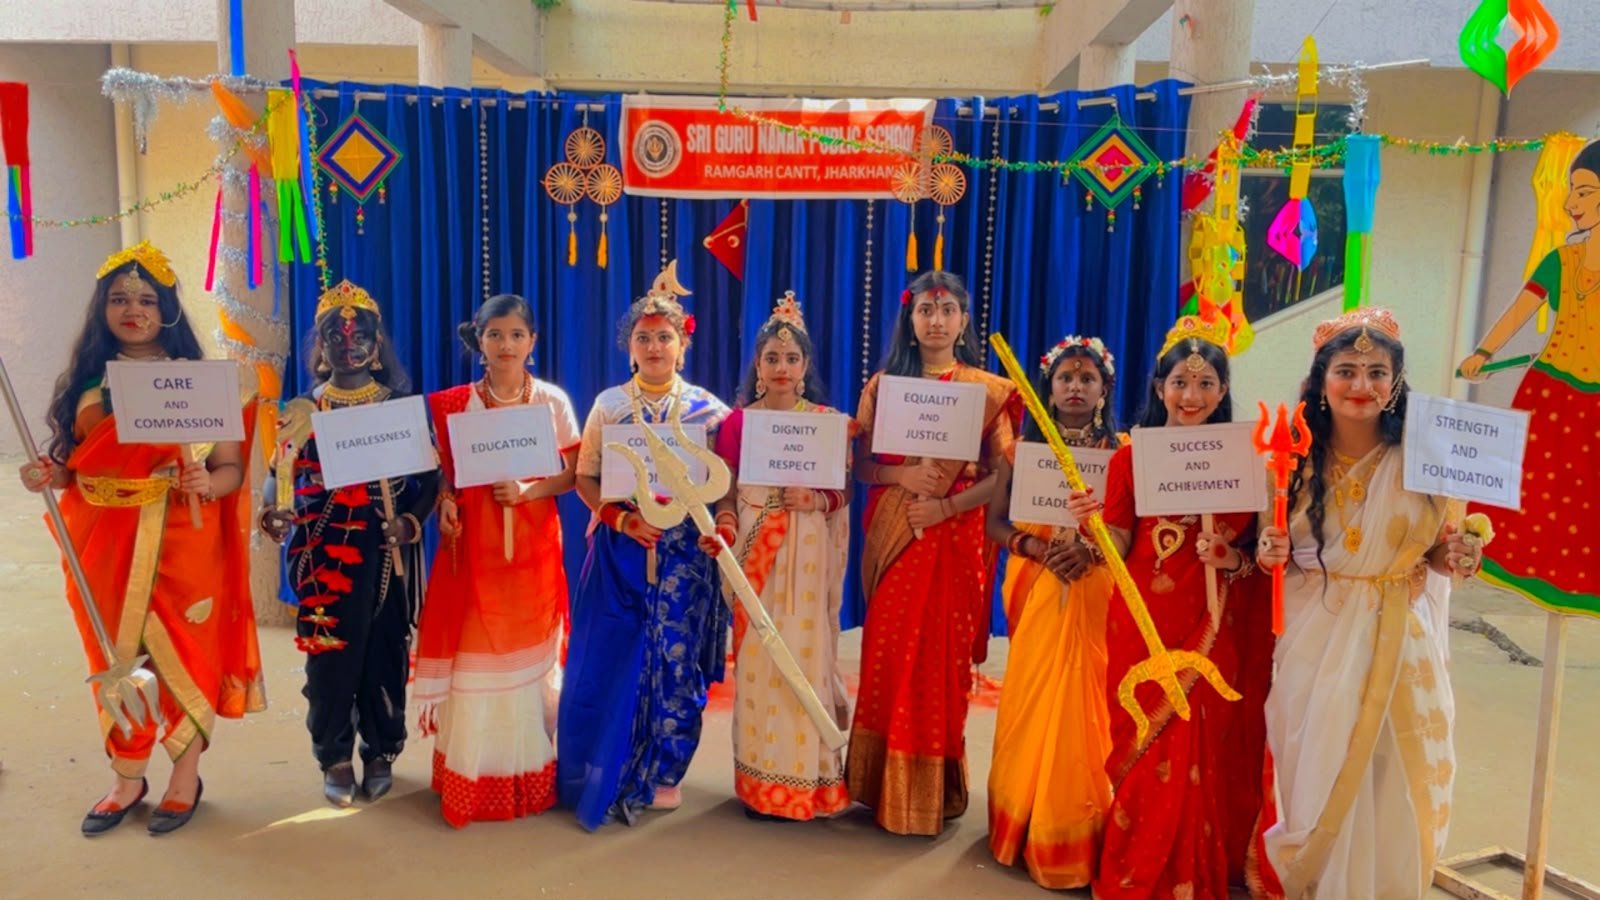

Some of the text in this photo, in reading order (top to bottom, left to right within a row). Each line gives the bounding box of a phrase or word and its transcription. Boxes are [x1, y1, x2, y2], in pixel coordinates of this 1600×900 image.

[686, 123, 711, 154] SRI
[715, 124, 754, 155] GURU
[757, 122, 806, 155] NANAK
[809, 125, 861, 155] PUBLIC
[704, 164, 903, 182] RAMGARH CANTT, JHARKHAN
[153, 377, 194, 390] CARE
[164, 400, 189, 410] AND
[904, 391, 959, 407] EQUALITY
[134, 417, 224, 430] COMPASSION
[918, 412, 940, 423] AND
[772, 424, 818, 436] DIGNITY
[1435, 414, 1499, 438] STRENGTH
[335, 428, 412, 452] FEARLESSNESS
[905, 429, 949, 442] JUSTICE
[471, 436, 538, 454] EDUCATION
[783, 443, 804, 453] AND
[1169, 440, 1224, 453] SUCCESS
[1450, 443, 1478, 459] AND
[768, 459, 817, 472] RESPECT
[1037, 458, 1107, 475] CREIVITY
[1184, 460, 1211, 472] AND
[1422, 463, 1504, 489] FOUNDATION
[1058, 480, 1077, 490] AN
[1157, 478, 1241, 493] ACHIEVEMENT
